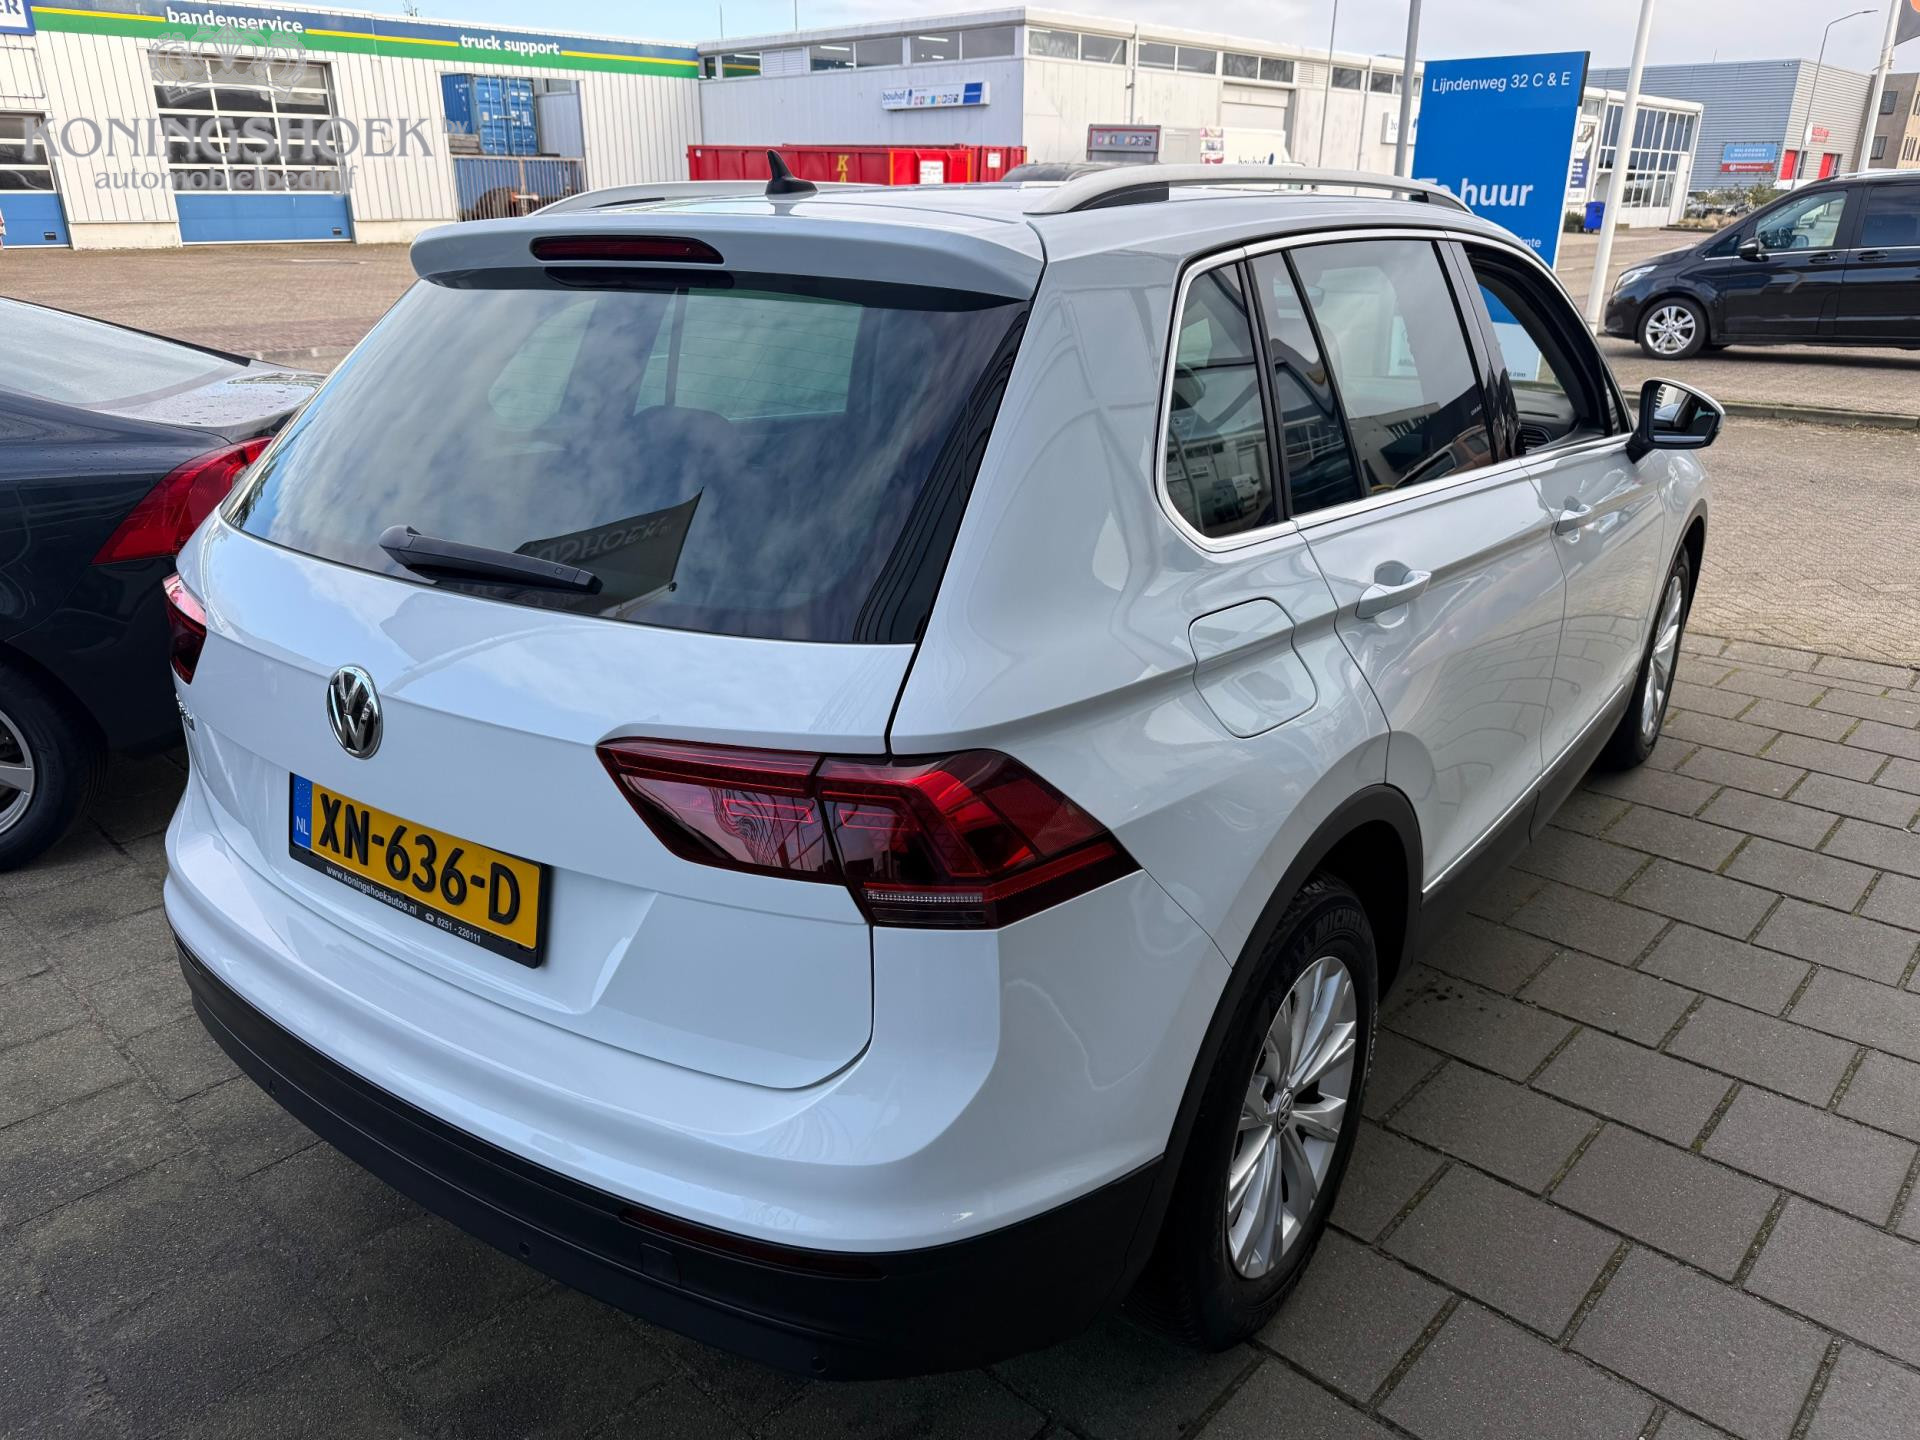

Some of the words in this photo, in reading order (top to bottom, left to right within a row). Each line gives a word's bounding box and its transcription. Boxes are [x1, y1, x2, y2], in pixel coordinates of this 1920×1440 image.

[166, 6, 303, 34] bandenservice
[460, 34, 501, 51] truck
[504, 40, 560, 57] support
[1432, 77, 1507, 94] Lijndenweg
[1510, 73, 1528, 88] 32
[1532, 72, 1544, 87] C
[1547, 72, 1557, 86] &
[1561, 71, 1571, 86] E
[1460, 178, 1534, 206] huur
[296, 815, 309, 836] NL
[318, 792, 521, 926] XN-636-D
[326, 865, 418, 916] www.koningshoekautos.nl
[437, 916, 452, 931] 0251
[458, 926, 481, 943] 220111
